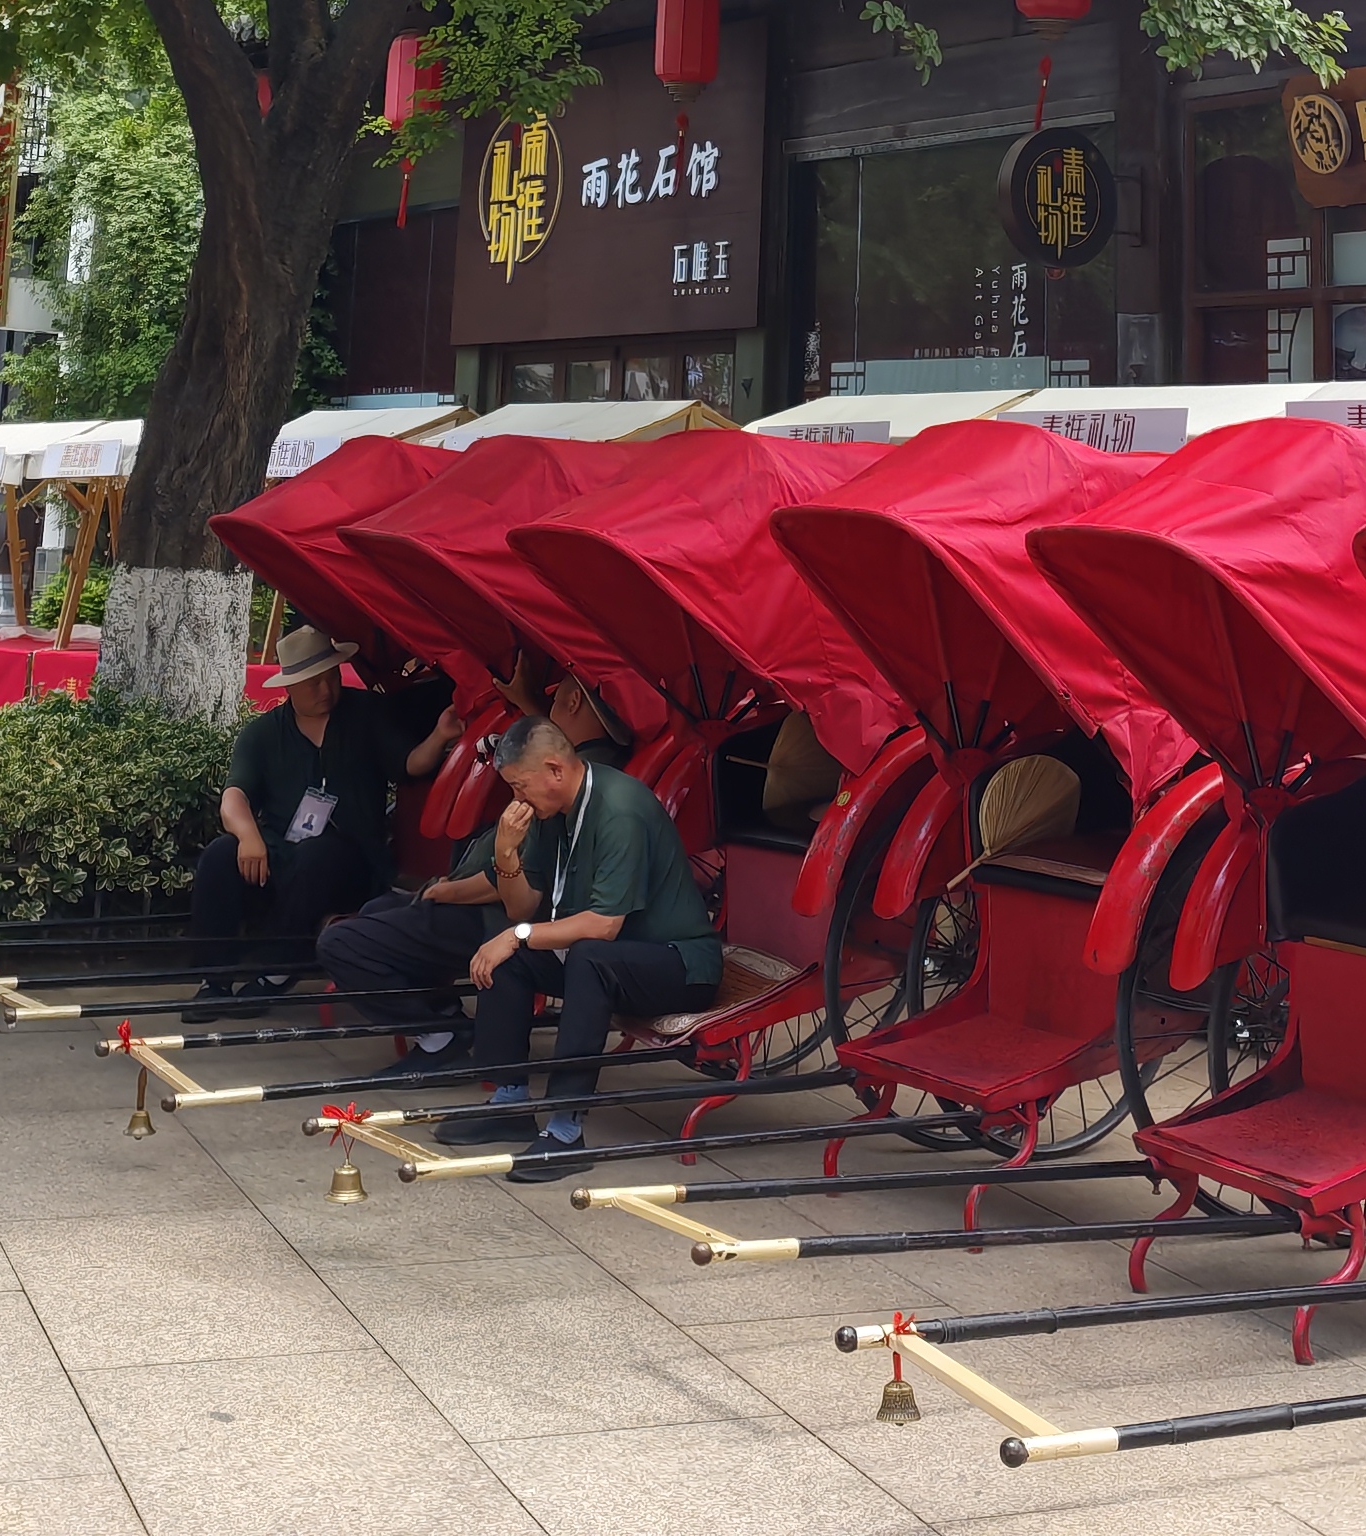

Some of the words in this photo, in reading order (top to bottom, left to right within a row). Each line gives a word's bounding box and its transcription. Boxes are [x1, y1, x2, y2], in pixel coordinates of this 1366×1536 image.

[582, 141, 720, 209] 雨花石馆
[975, 267, 984, 301] Art
[1010, 263, 1029, 386] 雨花石
